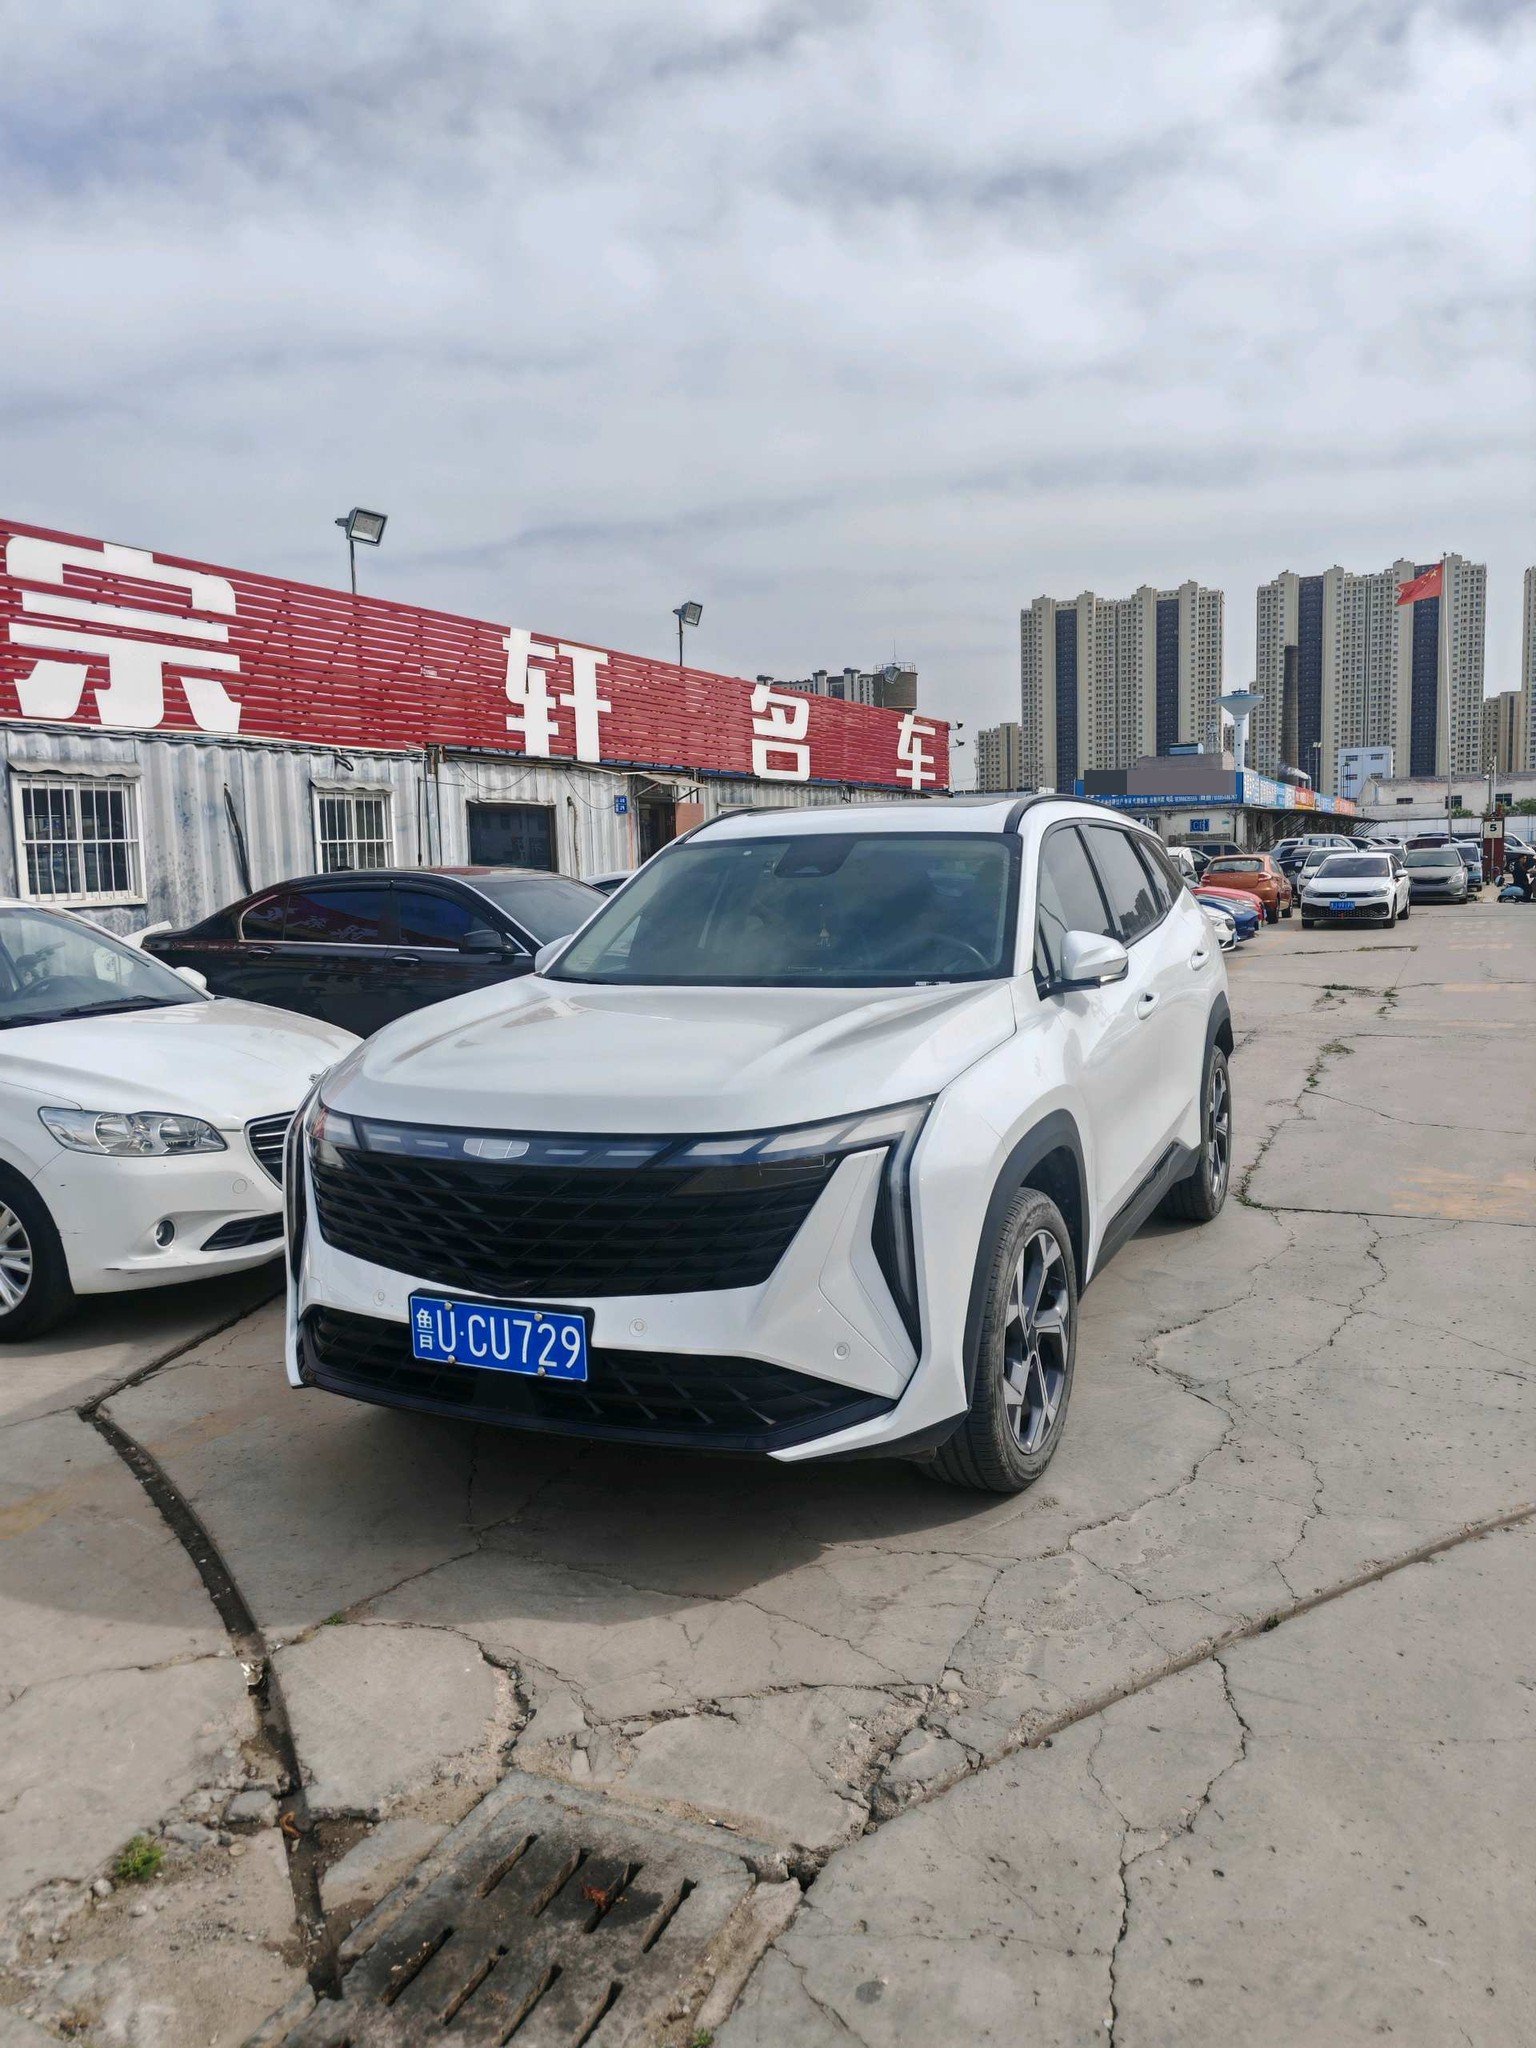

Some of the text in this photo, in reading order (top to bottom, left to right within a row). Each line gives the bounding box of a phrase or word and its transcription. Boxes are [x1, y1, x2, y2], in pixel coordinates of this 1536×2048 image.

[5, 536, 937, 790] 宗轩名车
[1490, 824, 1497, 832] 5
